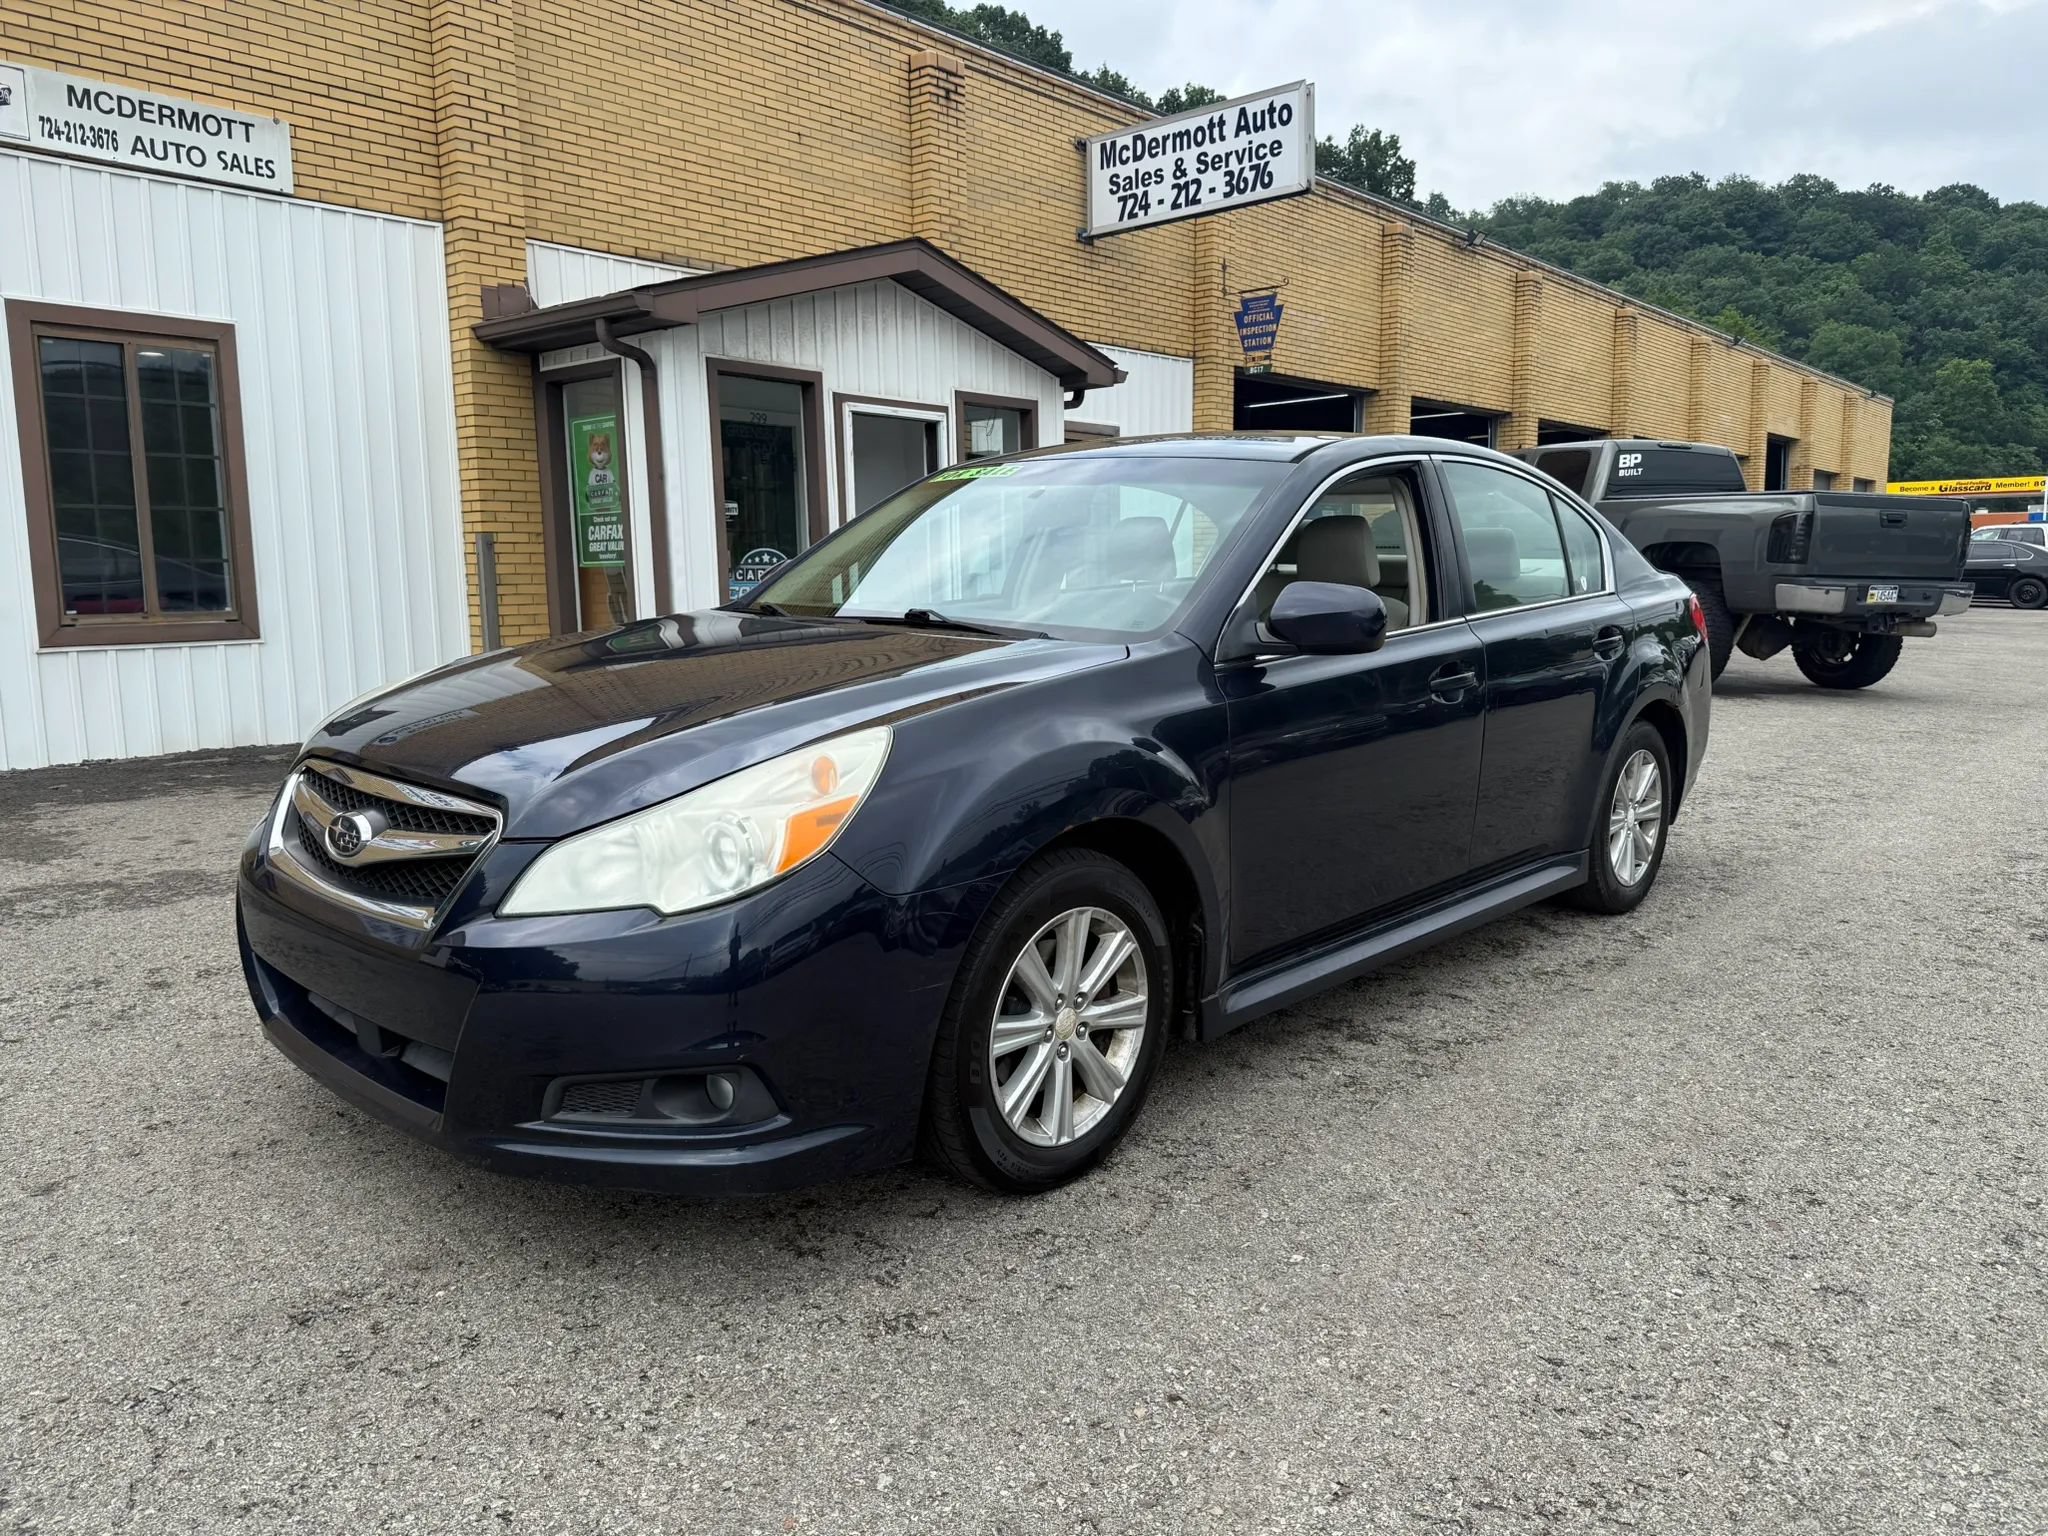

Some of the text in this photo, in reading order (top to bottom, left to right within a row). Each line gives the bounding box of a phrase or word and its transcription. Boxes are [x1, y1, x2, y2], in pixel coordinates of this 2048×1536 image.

[66, 84, 255, 143] MCDERMOTT
[38, 115, 119, 152] 724-212-3676
[1100, 99, 1293, 170] McDermott Auto
[130, 135, 276, 179] AUTO SALES
[1108, 138, 1283, 196] Sales & Service
[1117, 190, 1151, 222] 724
[1170, 178, 1202, 211] 212
[1223, 161, 1274, 199] 3676
[1244, 312, 1275, 323] OFFICIAL
[1240, 324, 1277, 336] INSPECTION
[1243, 336, 1272, 347] STATION
[1619, 453, 1642, 468] BP
[1619, 468, 1643, 476] BUILT
[1938, 483, 1992, 493] Glasscard
[588, 524, 623, 541] CARFAX
[589, 542, 607, 552] GREAT
